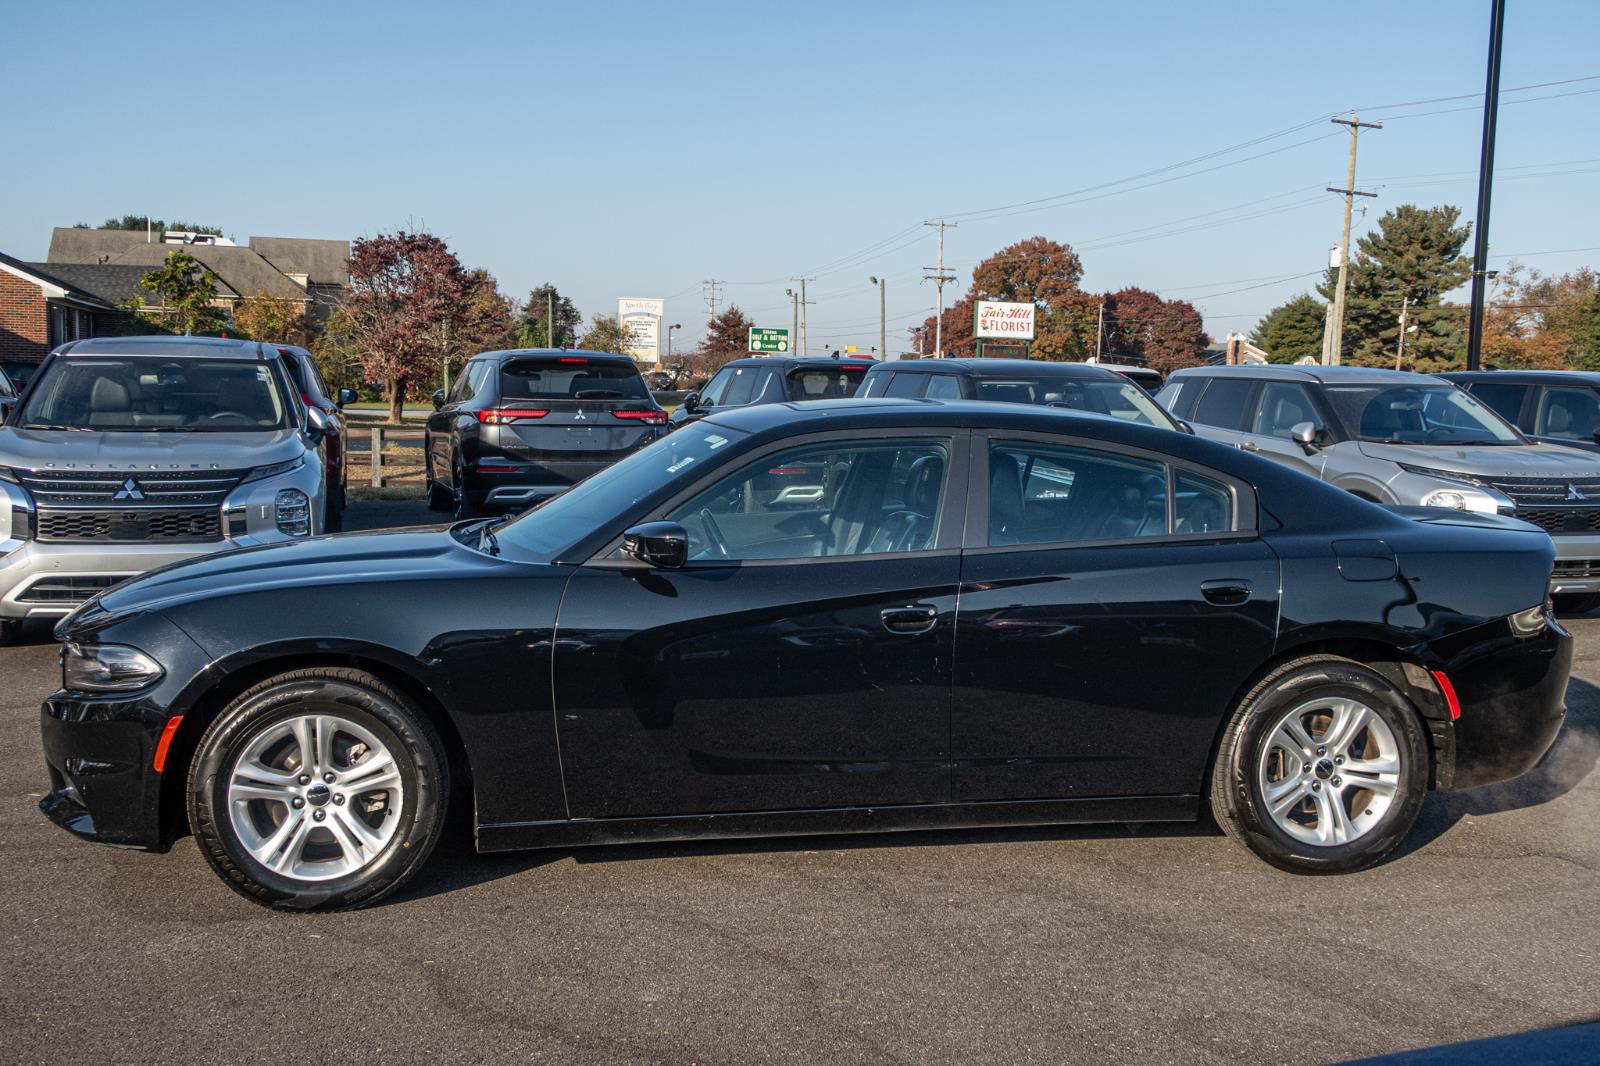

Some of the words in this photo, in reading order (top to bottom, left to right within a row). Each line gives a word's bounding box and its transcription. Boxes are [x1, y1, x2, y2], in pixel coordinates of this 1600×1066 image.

[981, 306, 1005, 318] Fair
[1006, 308, 1032, 318] Hill
[990, 320, 1031, 332] FLORIST
[44, 462, 220, 470] OUTLANDER
